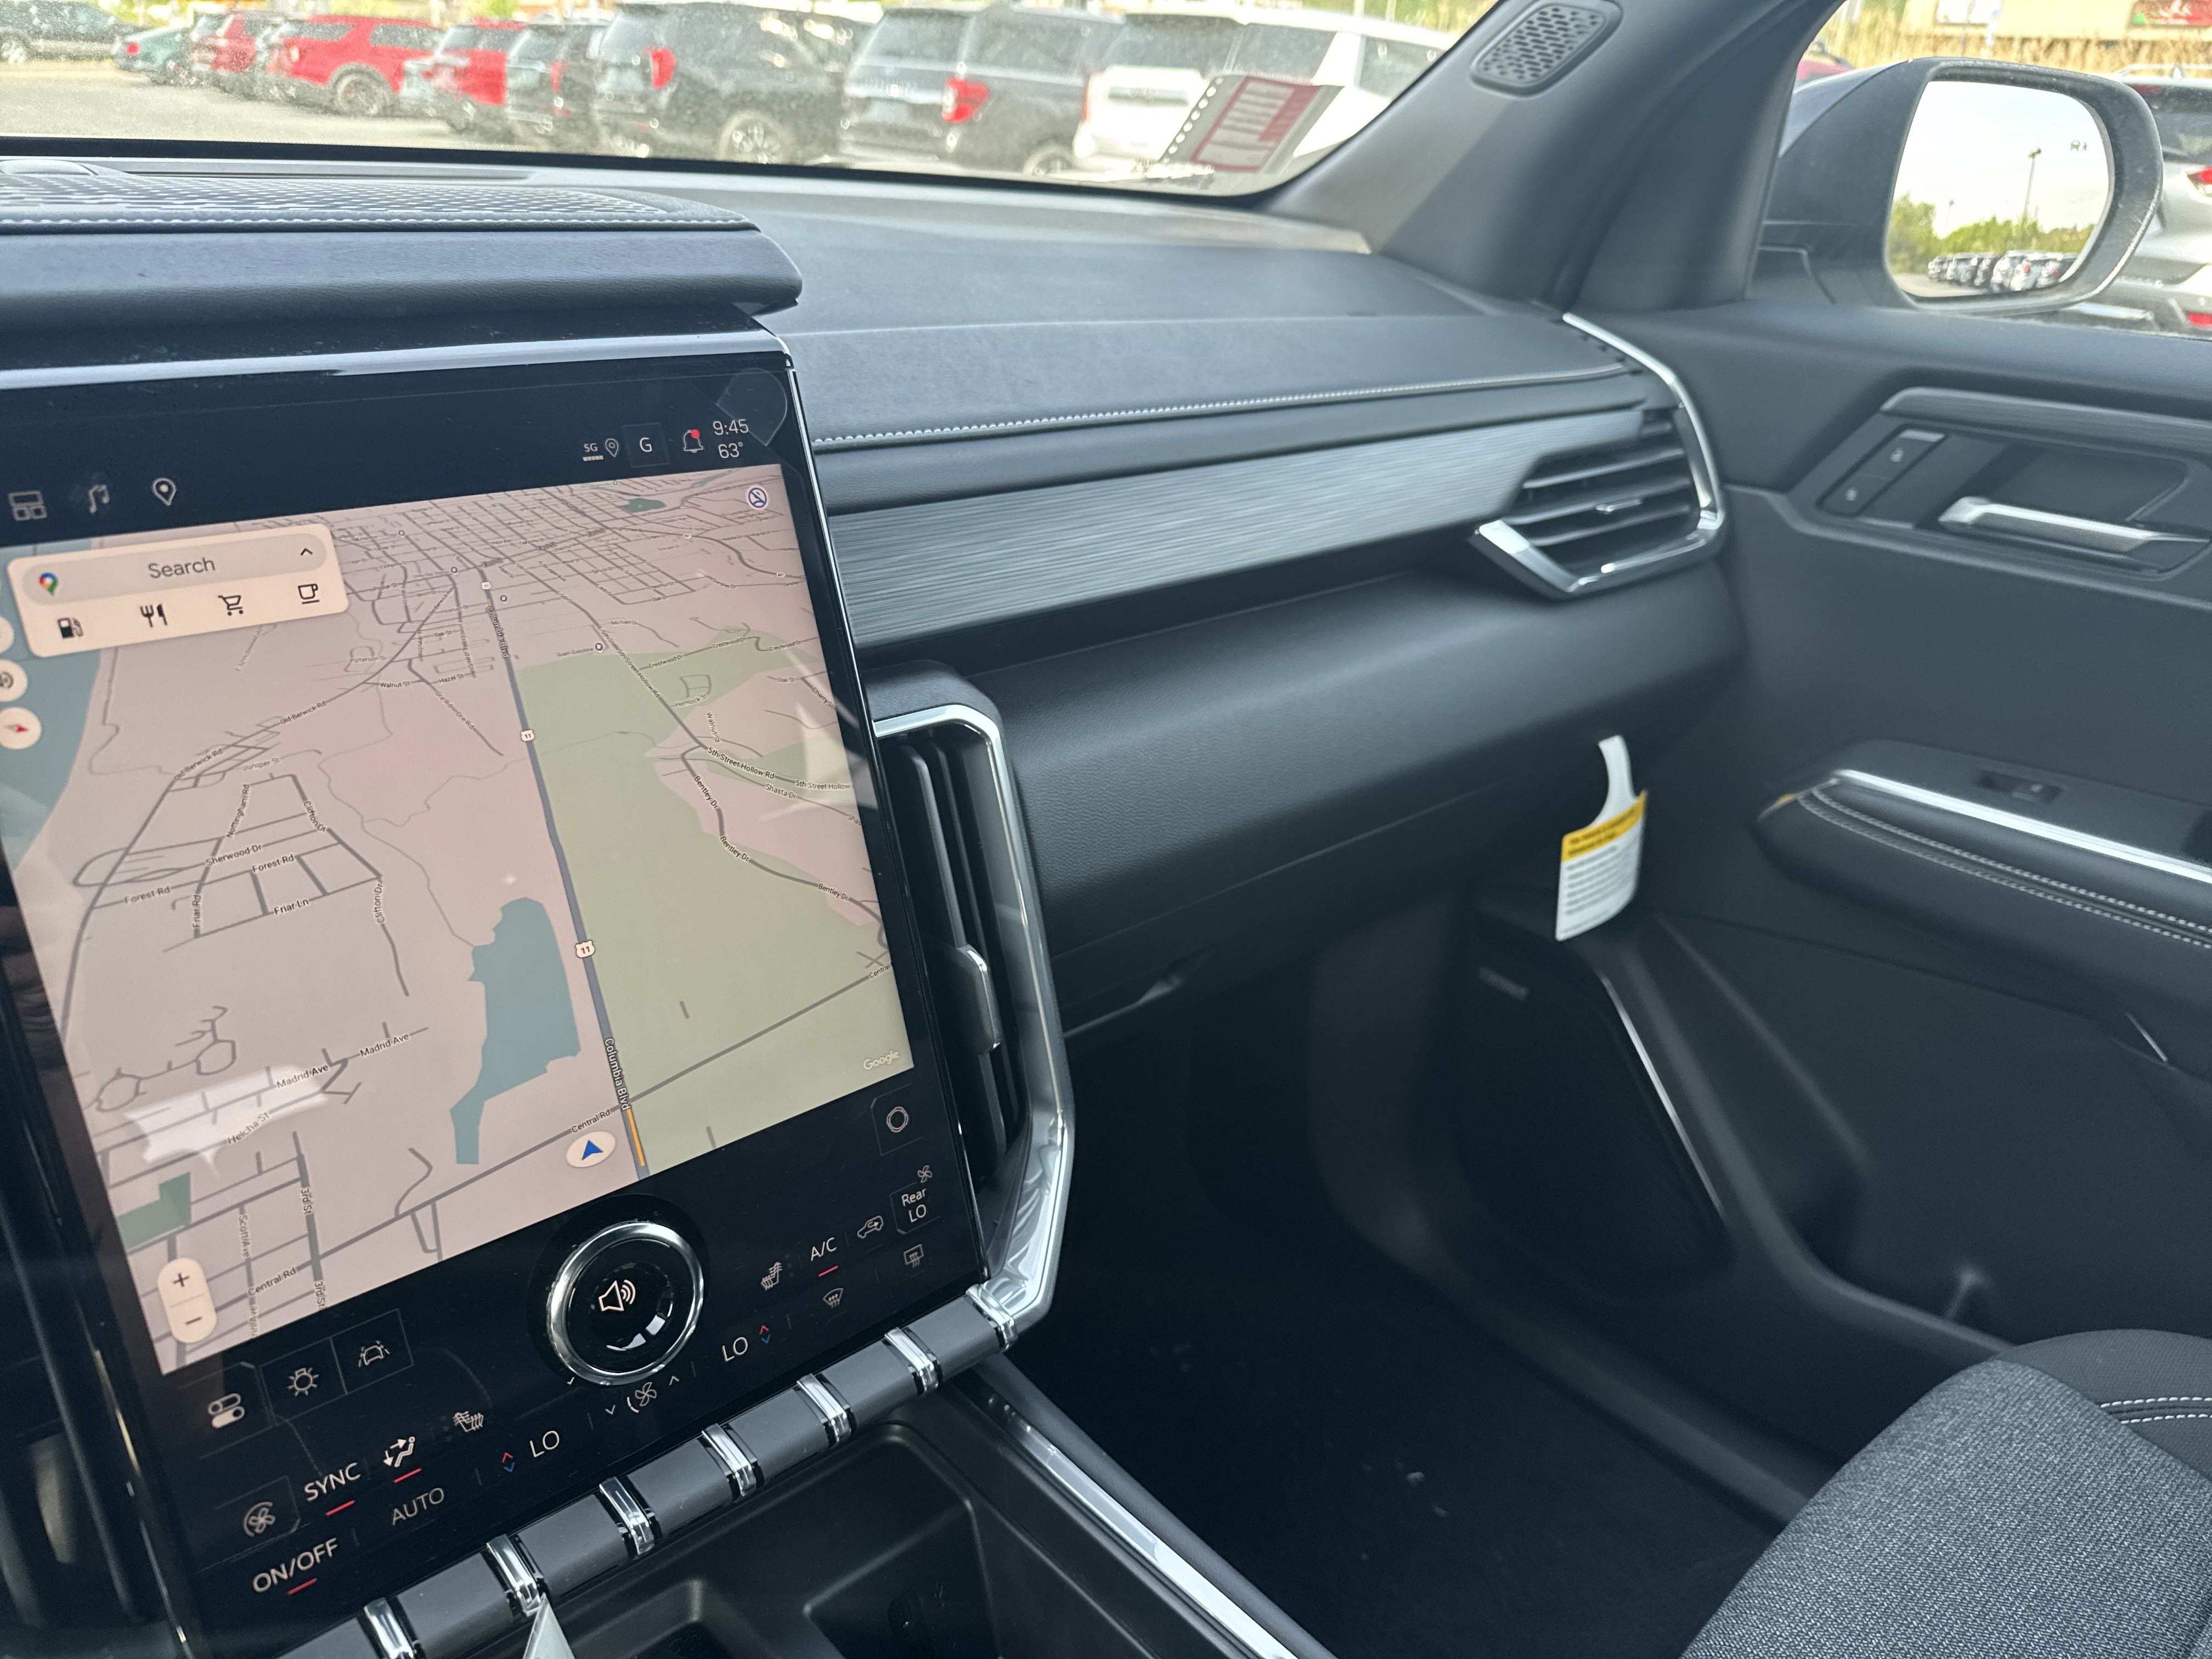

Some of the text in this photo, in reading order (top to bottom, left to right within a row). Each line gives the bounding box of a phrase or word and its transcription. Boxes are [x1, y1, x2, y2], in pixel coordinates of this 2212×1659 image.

[713, 419, 749, 435] 9:45
[583, 443, 598, 452] 5G
[639, 437, 652, 453] G
[718, 442, 743, 459] 63°
[148, 557, 216, 580] Search
[713, 639, 739, 648] Crestwood
[769, 642, 795, 651] Crestwood
[618, 649, 661, 698] 5th Street Hollow Rd
[648, 656, 676, 668] Crestwood
[675, 697, 701, 708] Hemlock
[812, 686, 828, 703] Cherry
[280, 716, 291, 725] Old
[291, 706, 317, 720] Berwick
[706, 712, 719, 737] Walnut
[184, 754, 212, 774] Berwick
[211, 748, 224, 758] Rd
[243, 760, 271, 771] Juniper
[708, 747, 775, 780] 5th Street Hollow Rd
[694, 775, 720, 810] Bentley Dr
[765, 783, 788, 797] Shasta
[226, 784, 250, 838] Nottingham Rd
[303, 800, 327, 833] Clifton Dr
[206, 843, 263, 866] Sherwood Dr
[720, 835, 751, 862] Bentley Dr
[252, 854, 295, 873] Forest Rd
[125, 885, 171, 905] Forest Rd
[374, 882, 385, 924] Clifton Dr
[818, 883, 849, 901] Bentley Dr
[192, 894, 202, 928] Friar Rd
[274, 898, 309, 916] Friar Ln
[581, 946, 590, 954] 11
[869, 963, 891, 979] Central
[360, 1032, 410, 1057] Madrid Ave
[863, 1050, 900, 1070] Google
[276, 1064, 329, 1089] Madrid Ave
[604, 1037, 632, 1111] Columbia Blvd
[257, 1111, 270, 1123] St
[572, 1108, 611, 1133] Central Rd
[301, 1187, 313, 1215] 3rd St
[901, 1188, 927, 1207] Rear
[909, 1204, 927, 1223] LO
[239, 1215, 251, 1258] Scott Ave
[810, 1237, 838, 1261] A/C
[248, 1267, 297, 1296] Central Rd
[314, 1281, 326, 1308] 3rd St
[721, 1336, 748, 1362] LO
[529, 1430, 560, 1459] LO
[303, 1462, 361, 1502] SYNC
[391, 1487, 445, 1526] AUTO
[251, 1537, 339, 1593] ON/OFF
